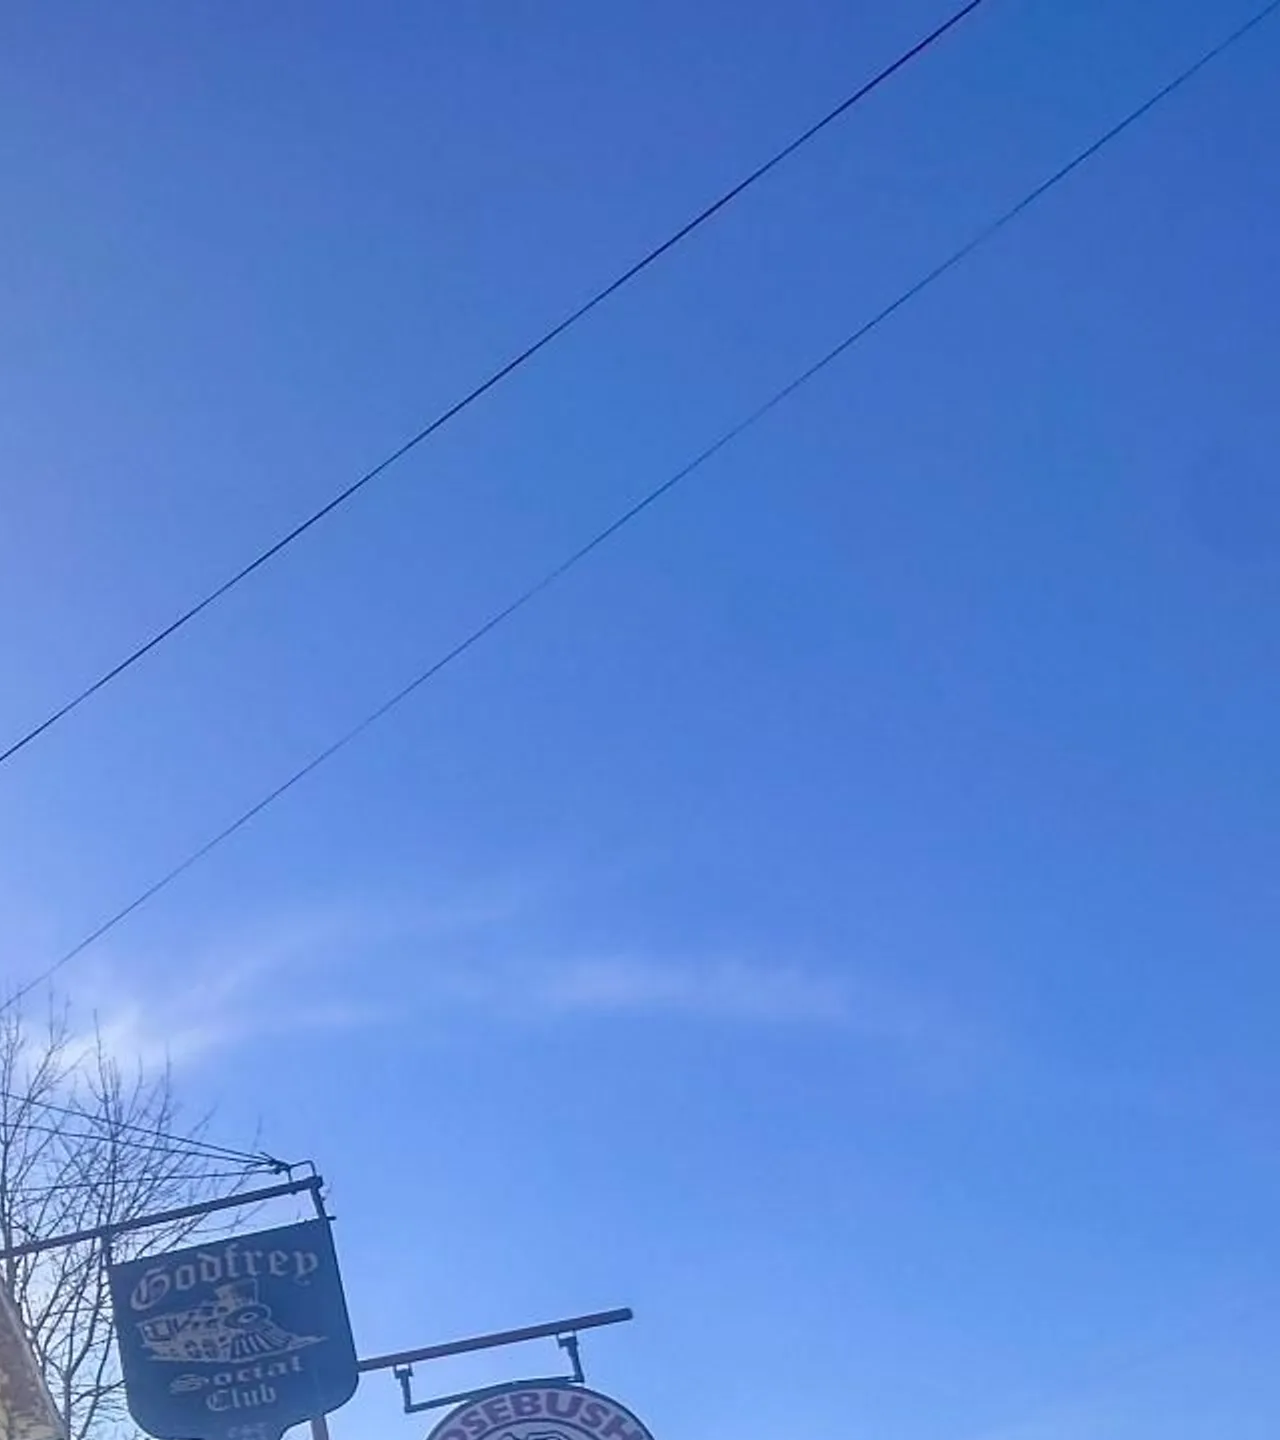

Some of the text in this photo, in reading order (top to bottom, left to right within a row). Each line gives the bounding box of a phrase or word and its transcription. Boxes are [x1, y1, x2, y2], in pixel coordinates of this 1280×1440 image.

[130, 1243, 320, 1311] Godfrey
[170, 1355, 305, 1395] Social
[206, 1384, 278, 1412] Club
